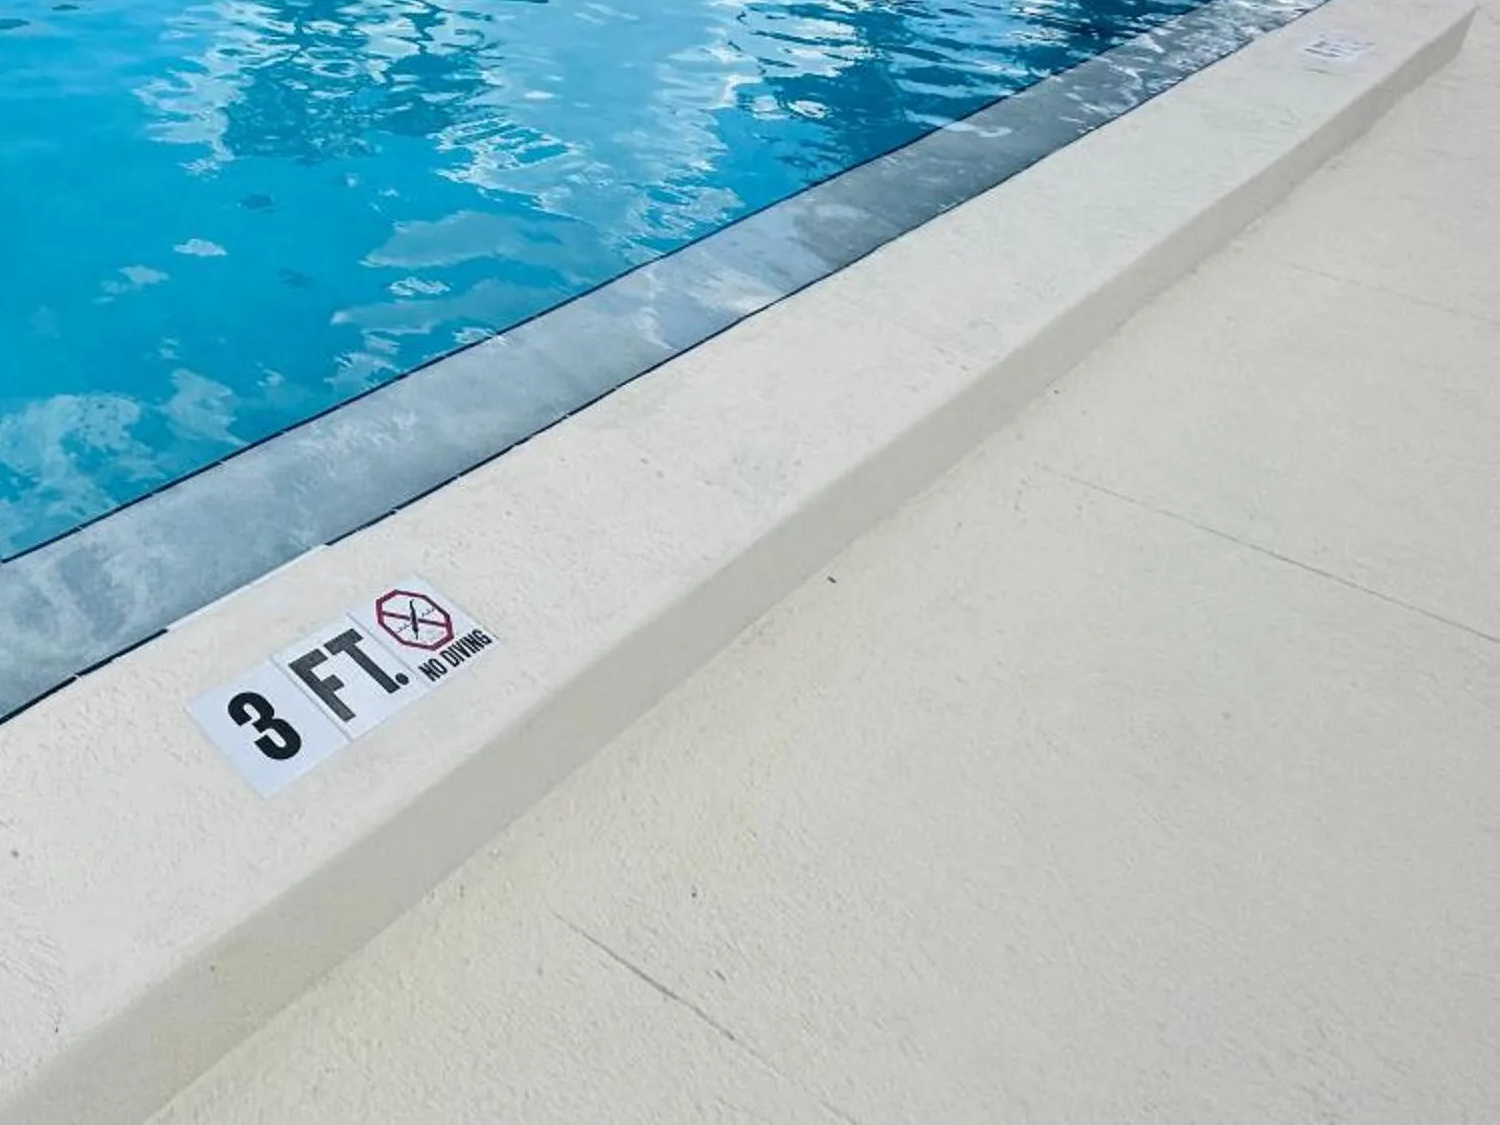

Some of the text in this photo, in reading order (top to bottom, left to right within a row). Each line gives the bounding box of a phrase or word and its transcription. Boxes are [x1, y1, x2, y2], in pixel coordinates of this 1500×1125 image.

[227, 628, 411, 761] 3 FT.
[417, 628, 494, 682] NO DIVING
